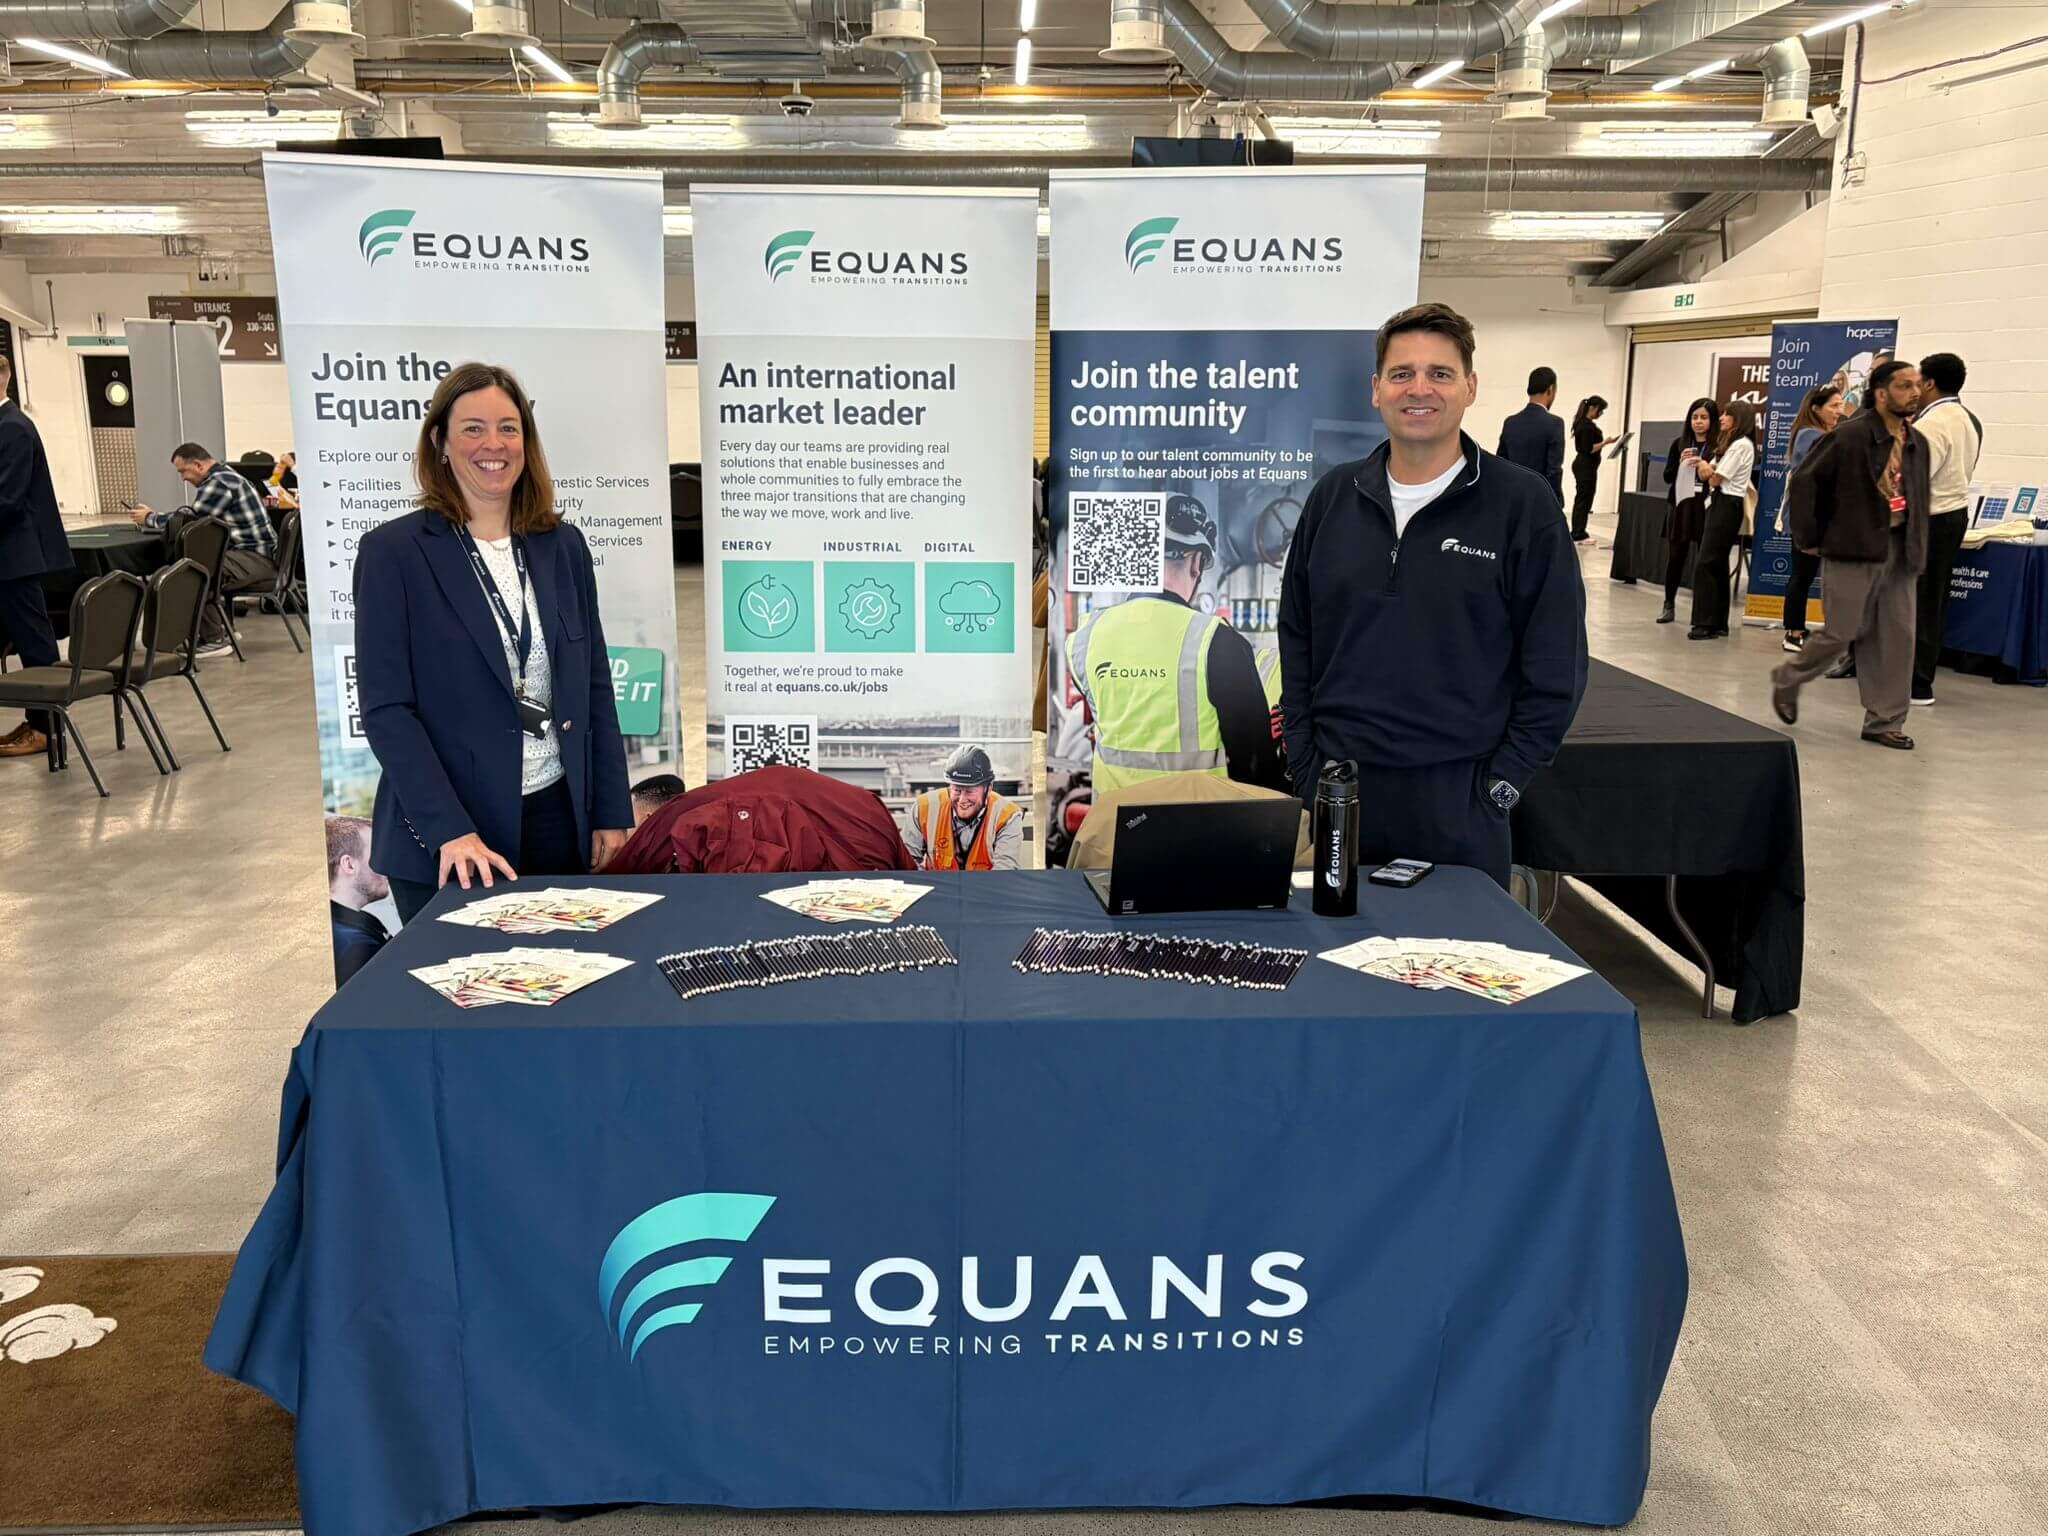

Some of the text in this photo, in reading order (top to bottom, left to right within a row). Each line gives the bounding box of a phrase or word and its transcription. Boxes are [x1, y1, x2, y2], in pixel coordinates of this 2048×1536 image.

[412, 232, 590, 261] EQUANS
[1173, 237, 1343, 263] EQUANS
[414, 260, 590, 273] EMPOWERING TRANSITIONS
[811, 251, 968, 275] EQUANS
[1173, 264, 1343, 274] EMPOWERING TRANSITIONS
[811, 276, 969, 286] EMPOWERING TRANSITIONS
[193, 302, 231, 313] ENTRANCE
[247, 322, 275, 332] 330-343
[1846, 326, 1874, 341] hcpc
[1778, 338, 1810, 354] Join
[311, 352, 452, 382] Join the
[1777, 358, 1805, 370] our
[719, 362, 956, 391] An international
[1070, 360, 1299, 390] Join the talent
[1741, 365, 1770, 383] THE
[1775, 372, 1819, 387] team!
[719, 398, 926, 426] market leader
[1070, 399, 1247, 434] community
[720, 440, 950, 456] Every day our teams are providing real
[1070, 447, 1313, 464] Sign up to our talent community to be
[318, 450, 373, 466] Explore
[375, 451, 399, 463] our
[720, 456, 945, 471] solutions that enable businesses and
[720, 473, 962, 489] whole communities to fully embrace the
[1070, 466, 1308, 482] the first to hear about jobs at Equans
[1763, 469, 1783, 479] Why
[338, 479, 402, 492] Facilities
[596, 475, 650, 489] Services
[340, 497, 418, 512] Manageme
[554, 496, 584, 511] urity
[720, 490, 966, 506] three major transitions that are changing
[721, 507, 914, 521] the way we move, work and live.
[580, 515, 663, 530] Management
[588, 535, 643, 547] Services
[721, 540, 976, 553] ENERGY INDUSTRIAL DIGITAL
[1453, 544, 1497, 560] EQUANS
[1976, 569, 1990, 578] care
[331, 607, 339, 620] it
[724, 665, 904, 680] Together, we're proud to make
[1110, 668, 1167, 678] EQUANS
[630, 681, 657, 702] IT
[724, 680, 888, 695] it real at equans.co.uk/jobs
[1331, 829, 1341, 875] EQUANS
[762, 1251, 1310, 1327] EQUANS
[764, 1328, 1305, 1356] EMPOWERING TRANSITIONS
